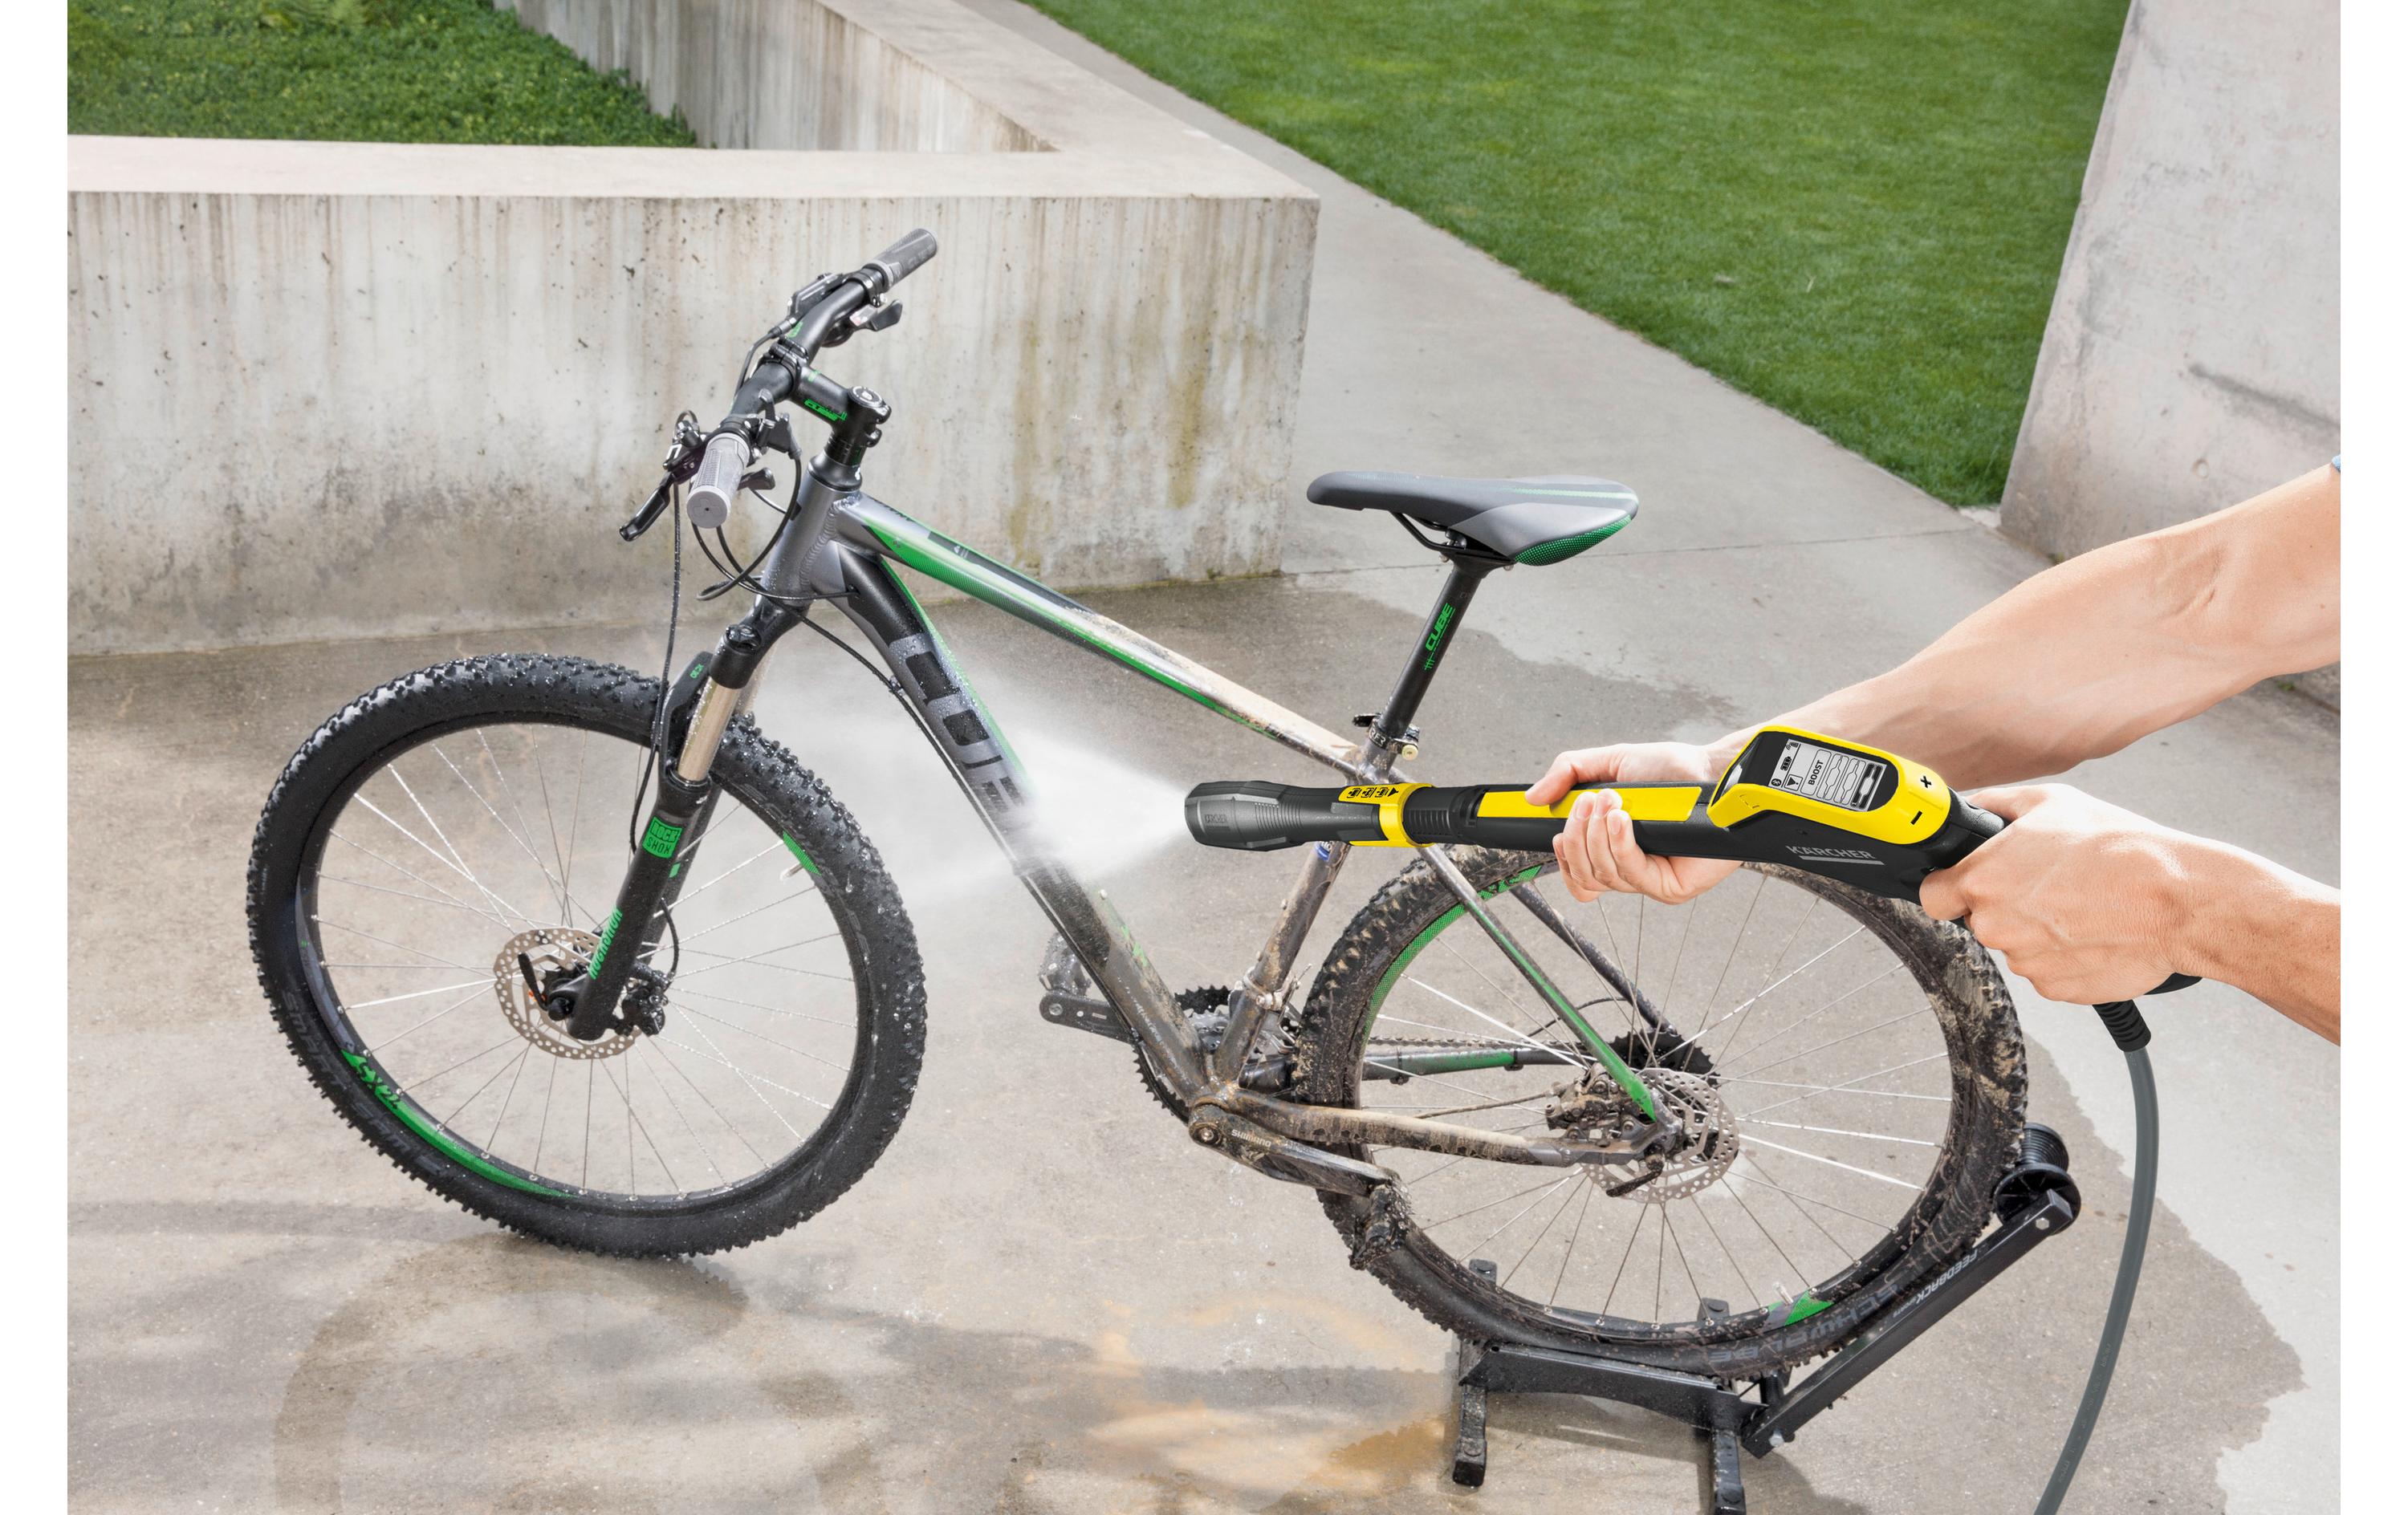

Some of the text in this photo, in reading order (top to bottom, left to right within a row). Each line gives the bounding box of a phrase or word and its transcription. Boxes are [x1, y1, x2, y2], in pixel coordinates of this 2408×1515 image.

[1425, 603, 1453, 652] CUBE
[1808, 760, 1824, 786] BOOST
[646, 835, 671, 855] SHOX
[650, 820, 678, 843] ROCK
[1914, 1248, 1979, 1305] FEEDBACK
[1708, 1285, 1901, 1363] SCHWALBE
